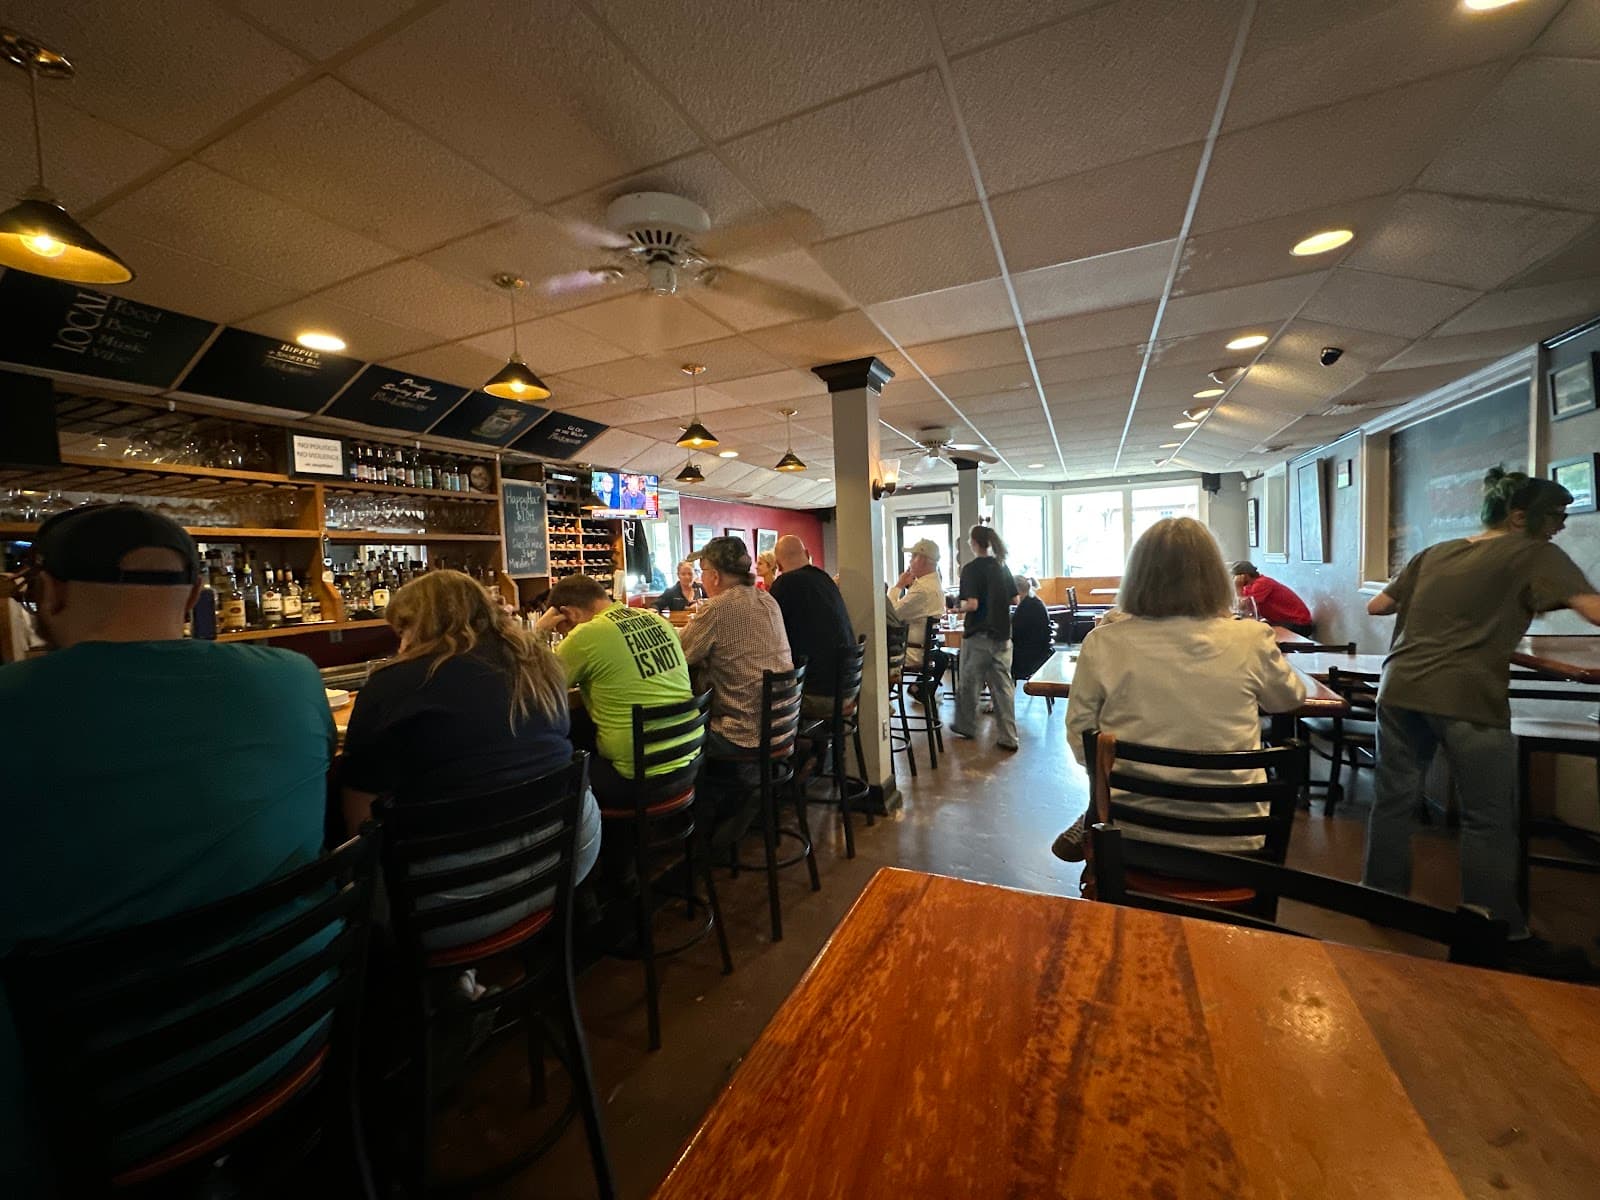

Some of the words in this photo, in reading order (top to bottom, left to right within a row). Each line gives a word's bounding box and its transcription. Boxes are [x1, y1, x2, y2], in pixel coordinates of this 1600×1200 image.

[51, 293, 112, 354] LOCAL
[624, 625, 672, 655] FAILURE
[634, 652, 656, 679] IS
[650, 643, 681, 673] NOT
